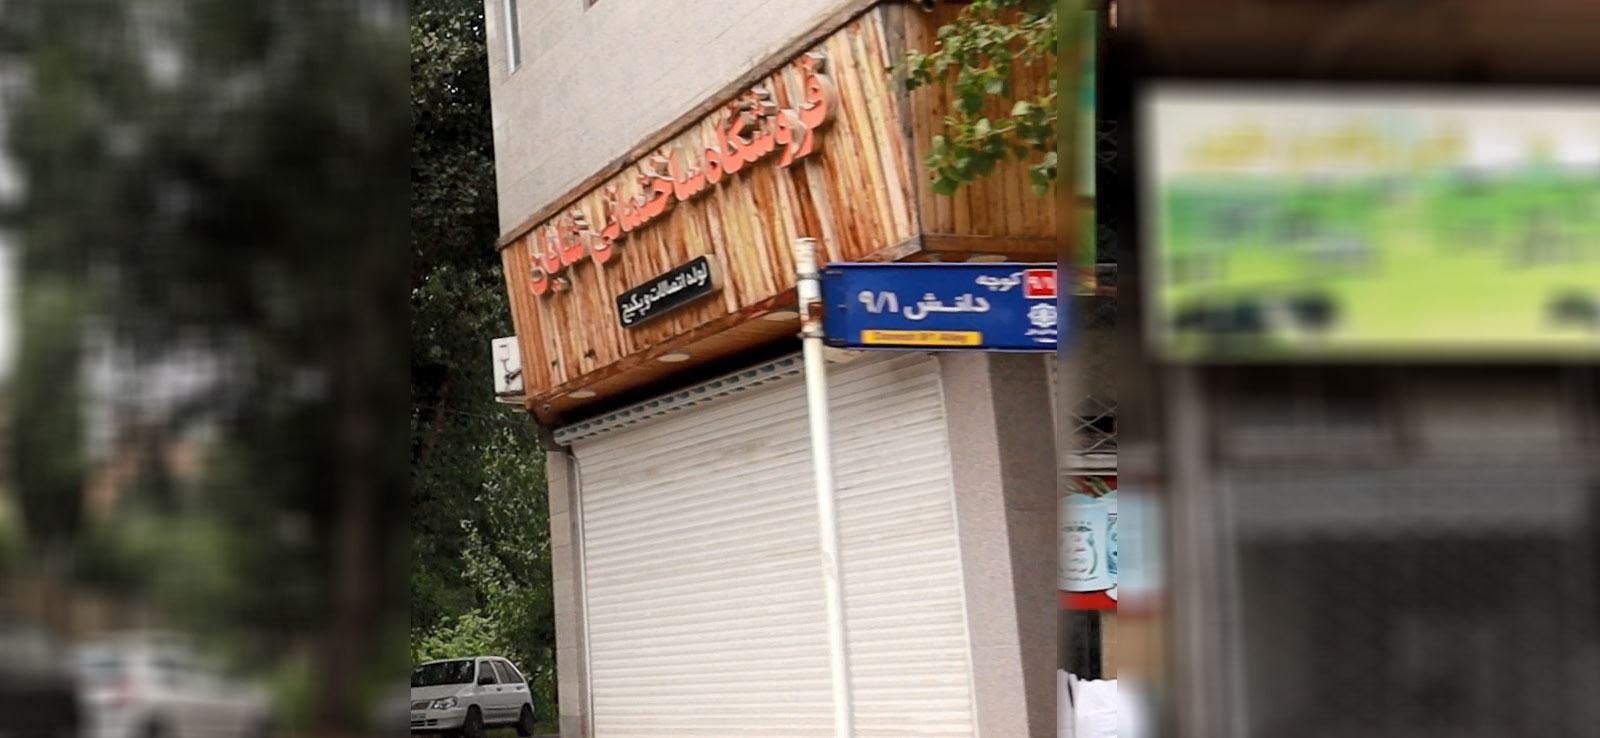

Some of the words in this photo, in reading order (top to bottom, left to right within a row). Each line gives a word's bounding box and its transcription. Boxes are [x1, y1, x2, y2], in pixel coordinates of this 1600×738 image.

[705, 52, 828, 183] فروشگاه
[592, 149, 706, 264] ساختمانی
[650, 273, 687, 302] اتصالات
[685, 262, 708, 286] لوله
[975, 271, 1024, 292] کوچه
[621, 294, 646, 323] پکیج
[858, 291, 899, 313] ۹/۱
[903, 293, 990, 320] دانش
